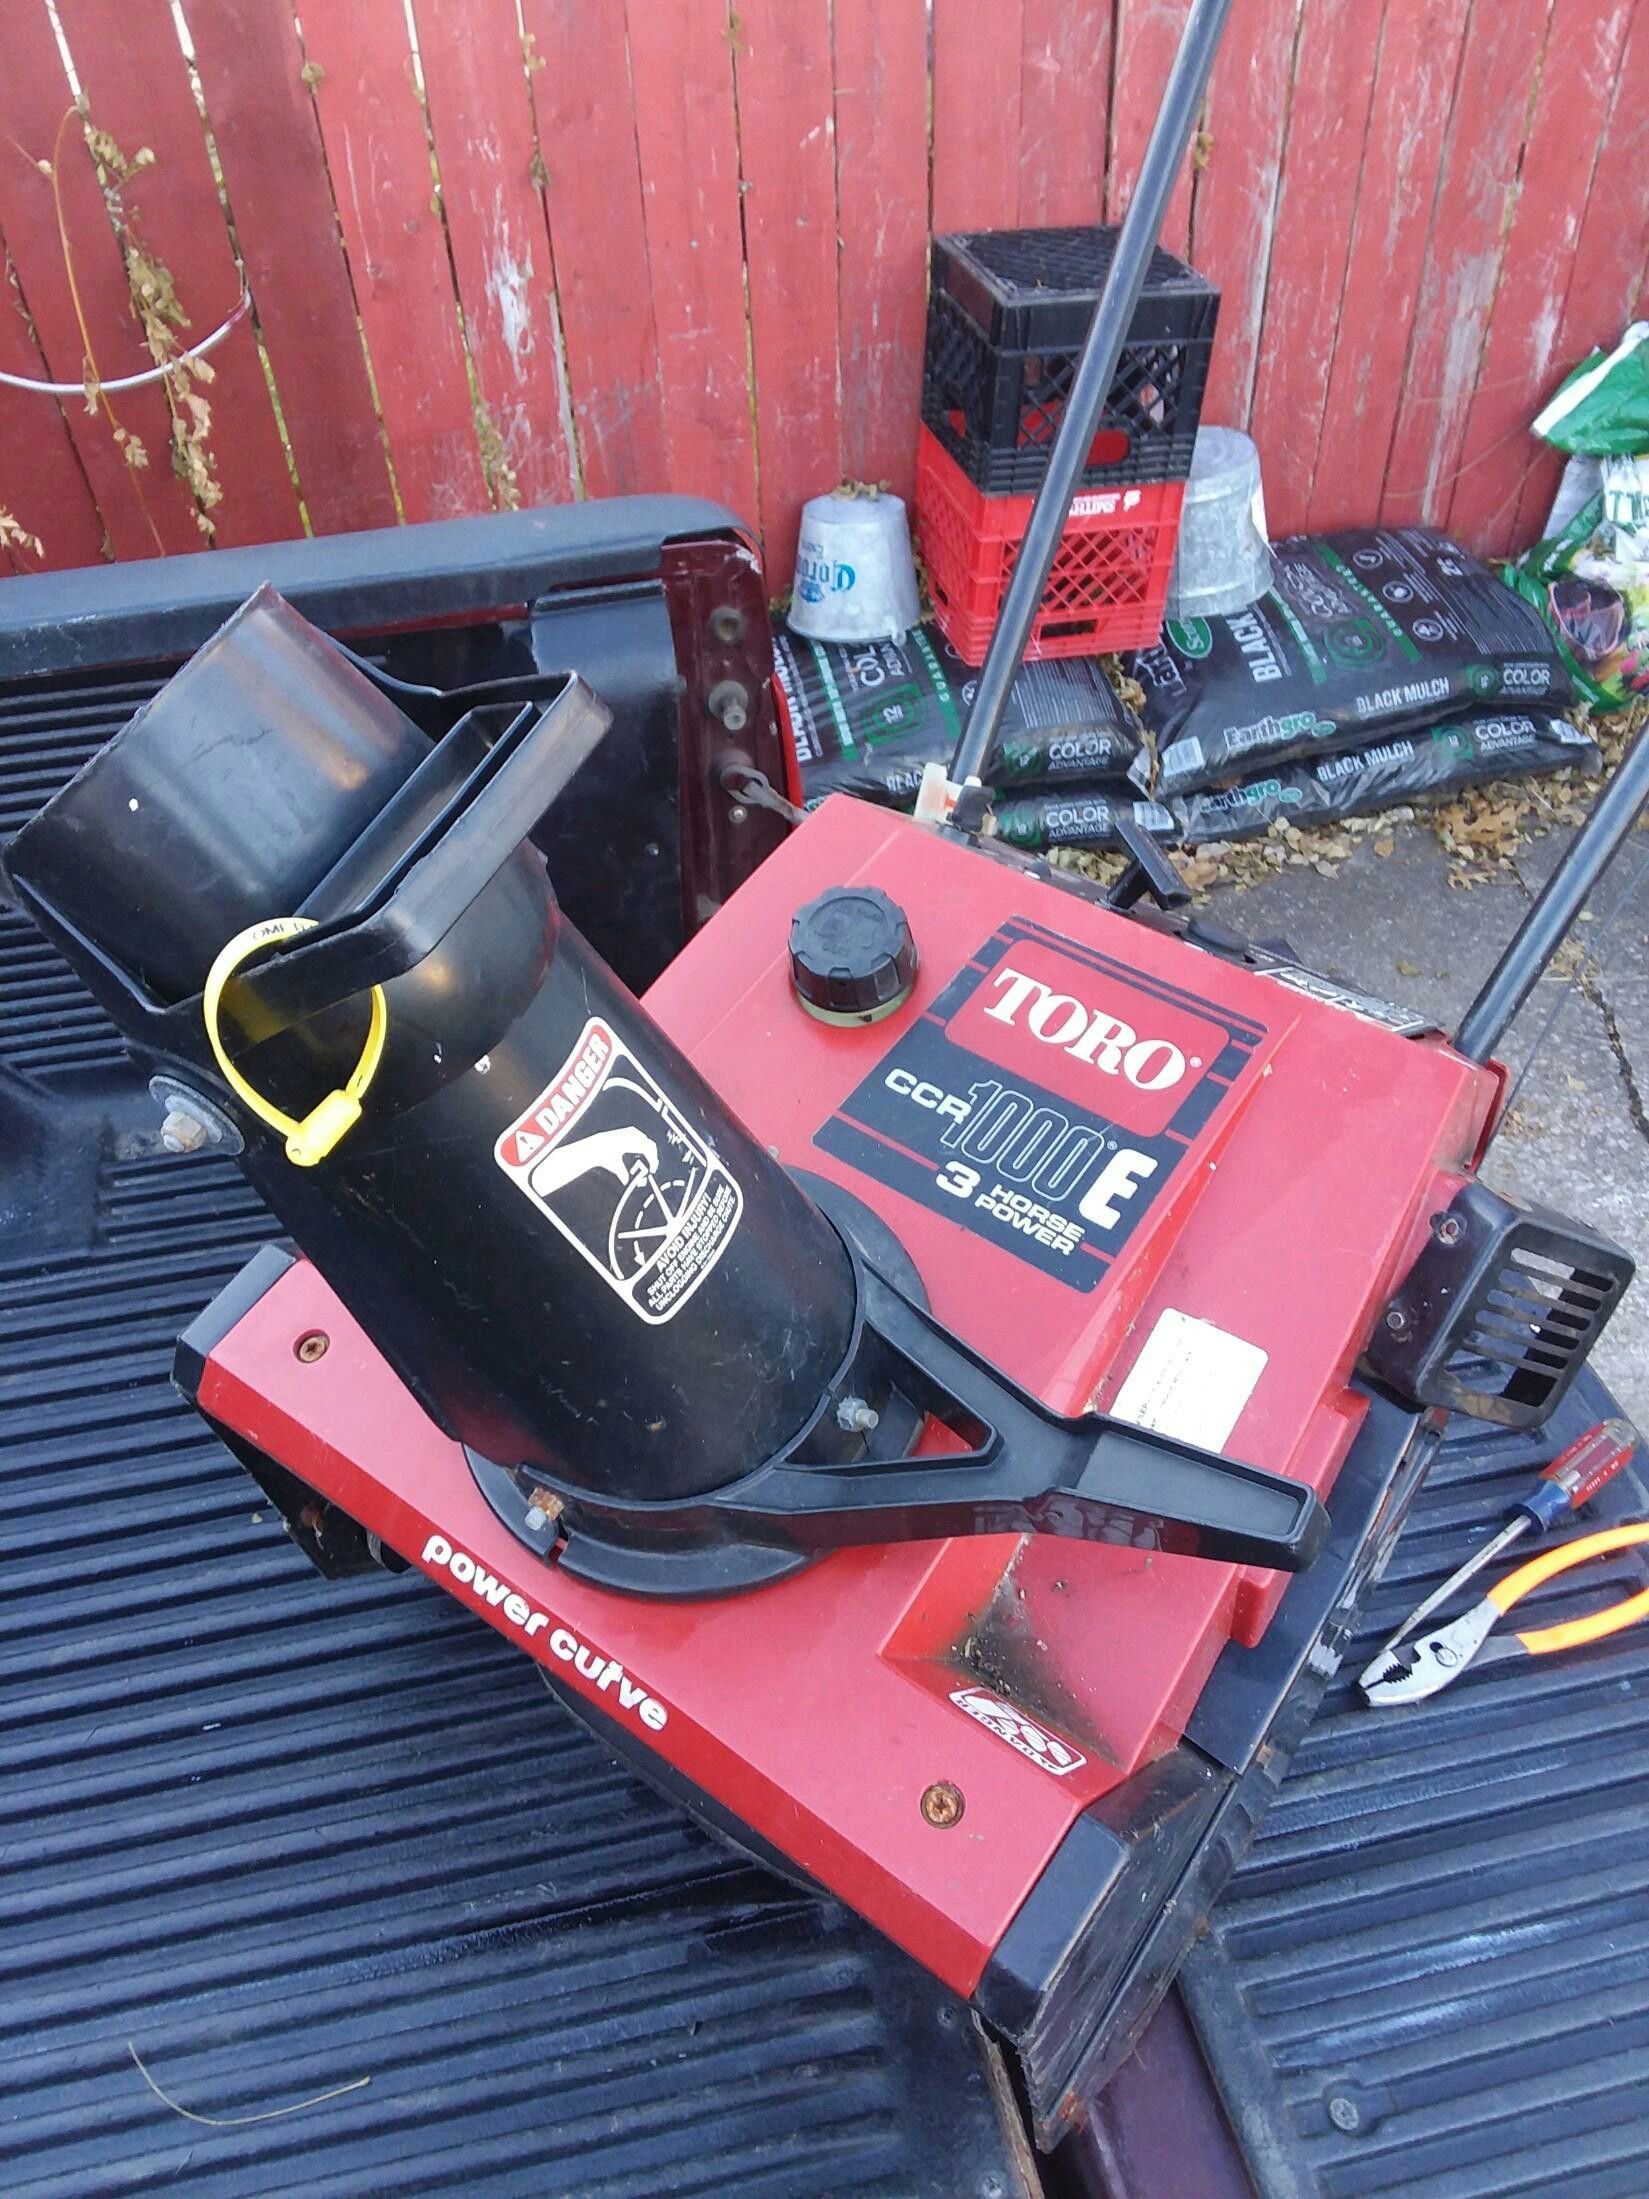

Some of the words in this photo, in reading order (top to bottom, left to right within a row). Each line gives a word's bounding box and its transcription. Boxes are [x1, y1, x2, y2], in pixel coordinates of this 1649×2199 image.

[853, 645, 886, 687] COL
[1502, 669, 1551, 686] COLOR
[1356, 687, 1403, 714] BLACK
[1403, 676, 1450, 705] MULCH
[1048, 736, 1112, 761] COLOR
[1223, 710, 1317, 752] Earthgro
[1475, 719, 1536, 741] COLOR
[1480, 736, 1536, 751] ADVANTAGE
[885, 769, 923, 794] BLAC
[1048, 756, 1110, 771] ADVANTAGE
[1315, 756, 1364, 783] BLACK
[1367, 740, 1415, 769] MULCH
[1046, 806, 1111, 829] COLOR
[1049, 824, 1109, 839] ADVANTAGE
[983, 967, 1186, 1091] TORO
[536, 1033, 609, 1136] DANGER
[884, 1068, 973, 1126] CCR
[1078, 1148, 1159, 1232] E
[935, 1160, 981, 1200] 3
[656, 1236, 685, 1273] AVOID
[681, 1191, 712, 1241] INJURY!
[974, 1192, 1078, 1257] POWER
[989, 1183, 1086, 1240] HORSE
[647, 1272, 668, 1297] SHUT
[665, 1259, 679, 1278] OFF
[677, 1232, 700, 1262] ENGINE
[698, 1215, 711, 1235] AND
[712, 1183, 725, 1207] SURE
[648, 1290, 665, 1308] ALL
[662, 1268, 683, 1295] PARTS
[680, 1247, 699, 1272] HAVE
[696, 1214, 719, 1252] STOPPED
[716, 1184, 732, 1218] BEFORE
[655, 1262, 698, 1312] UNCLOGGING
[695, 1222, 725, 1267] DISCHARGE
[721, 1196, 736, 1223] CHUTE
[420, 1534, 550, 1638] power
[547, 1626, 670, 1732] curve
